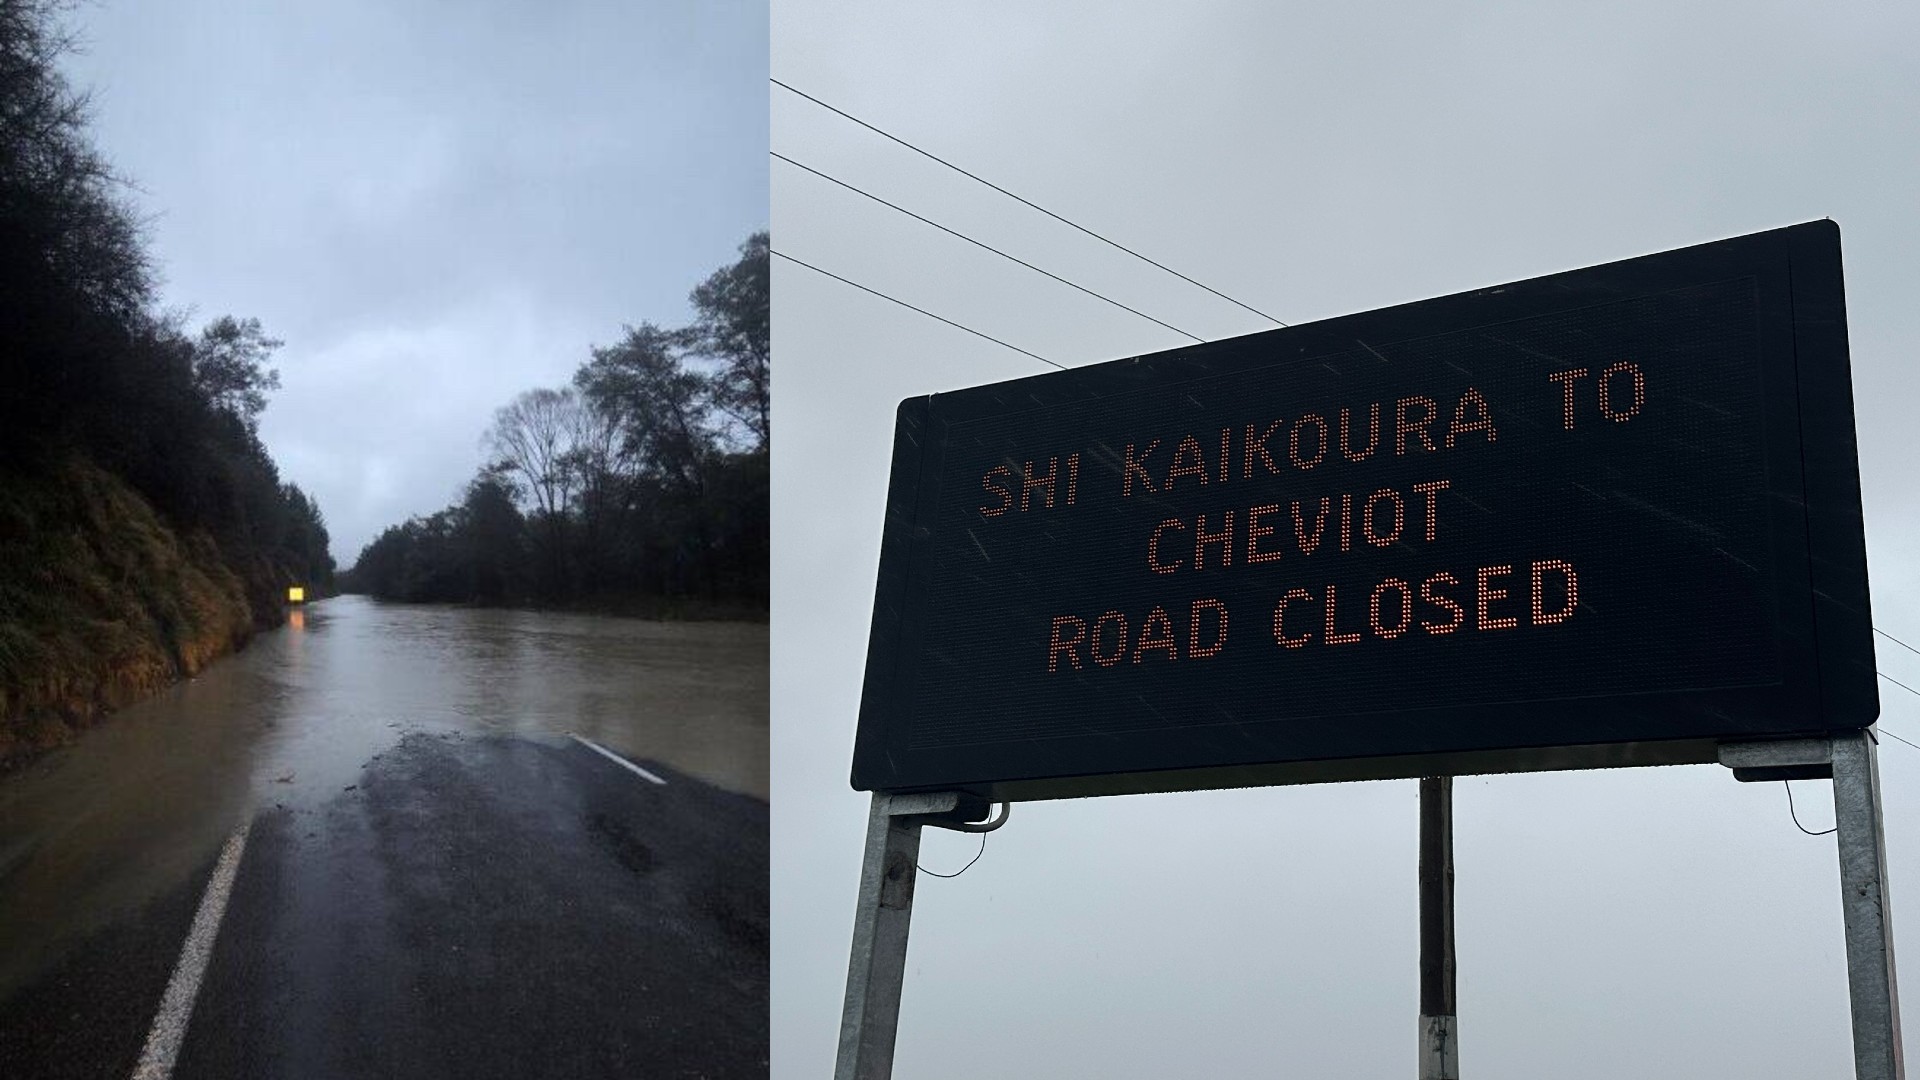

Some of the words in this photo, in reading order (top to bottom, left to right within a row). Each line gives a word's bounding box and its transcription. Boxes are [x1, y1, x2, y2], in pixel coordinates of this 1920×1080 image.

[979, 453, 1080, 518] SH1
[1122, 387, 1498, 497] KAIKOURA
[1549, 361, 1647, 430] TO
[1147, 480, 1451, 575] CHEVIOT
[1048, 599, 1229, 673] ROAD
[1273, 559, 1579, 649] CLOSED
